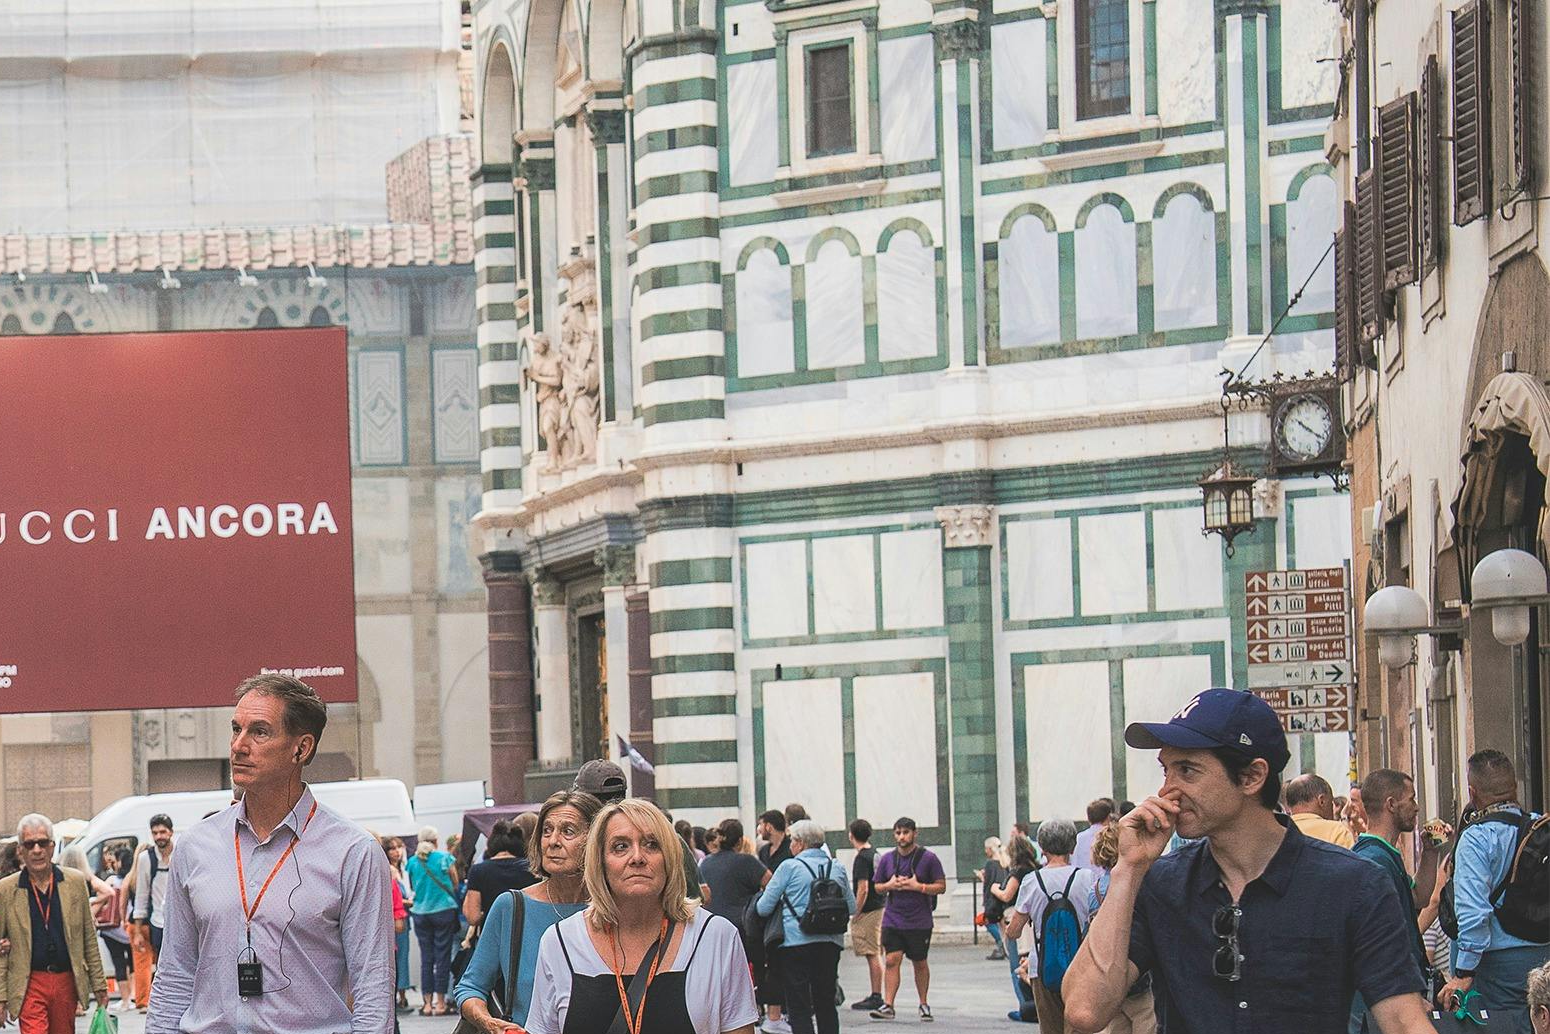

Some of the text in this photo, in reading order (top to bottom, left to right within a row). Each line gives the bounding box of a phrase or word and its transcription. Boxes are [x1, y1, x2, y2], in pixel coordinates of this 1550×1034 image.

[145, 501, 339, 540] ANCORA
[1314, 594, 1342, 604] palazzo
[1324, 602, 1342, 610] Pitti
[1311, 625, 1343, 635] Signoria
[1309, 640, 1343, 651] opera del
[1319, 650, 1344, 659] Duomo
[293, 666, 345, 680] gucci.com
